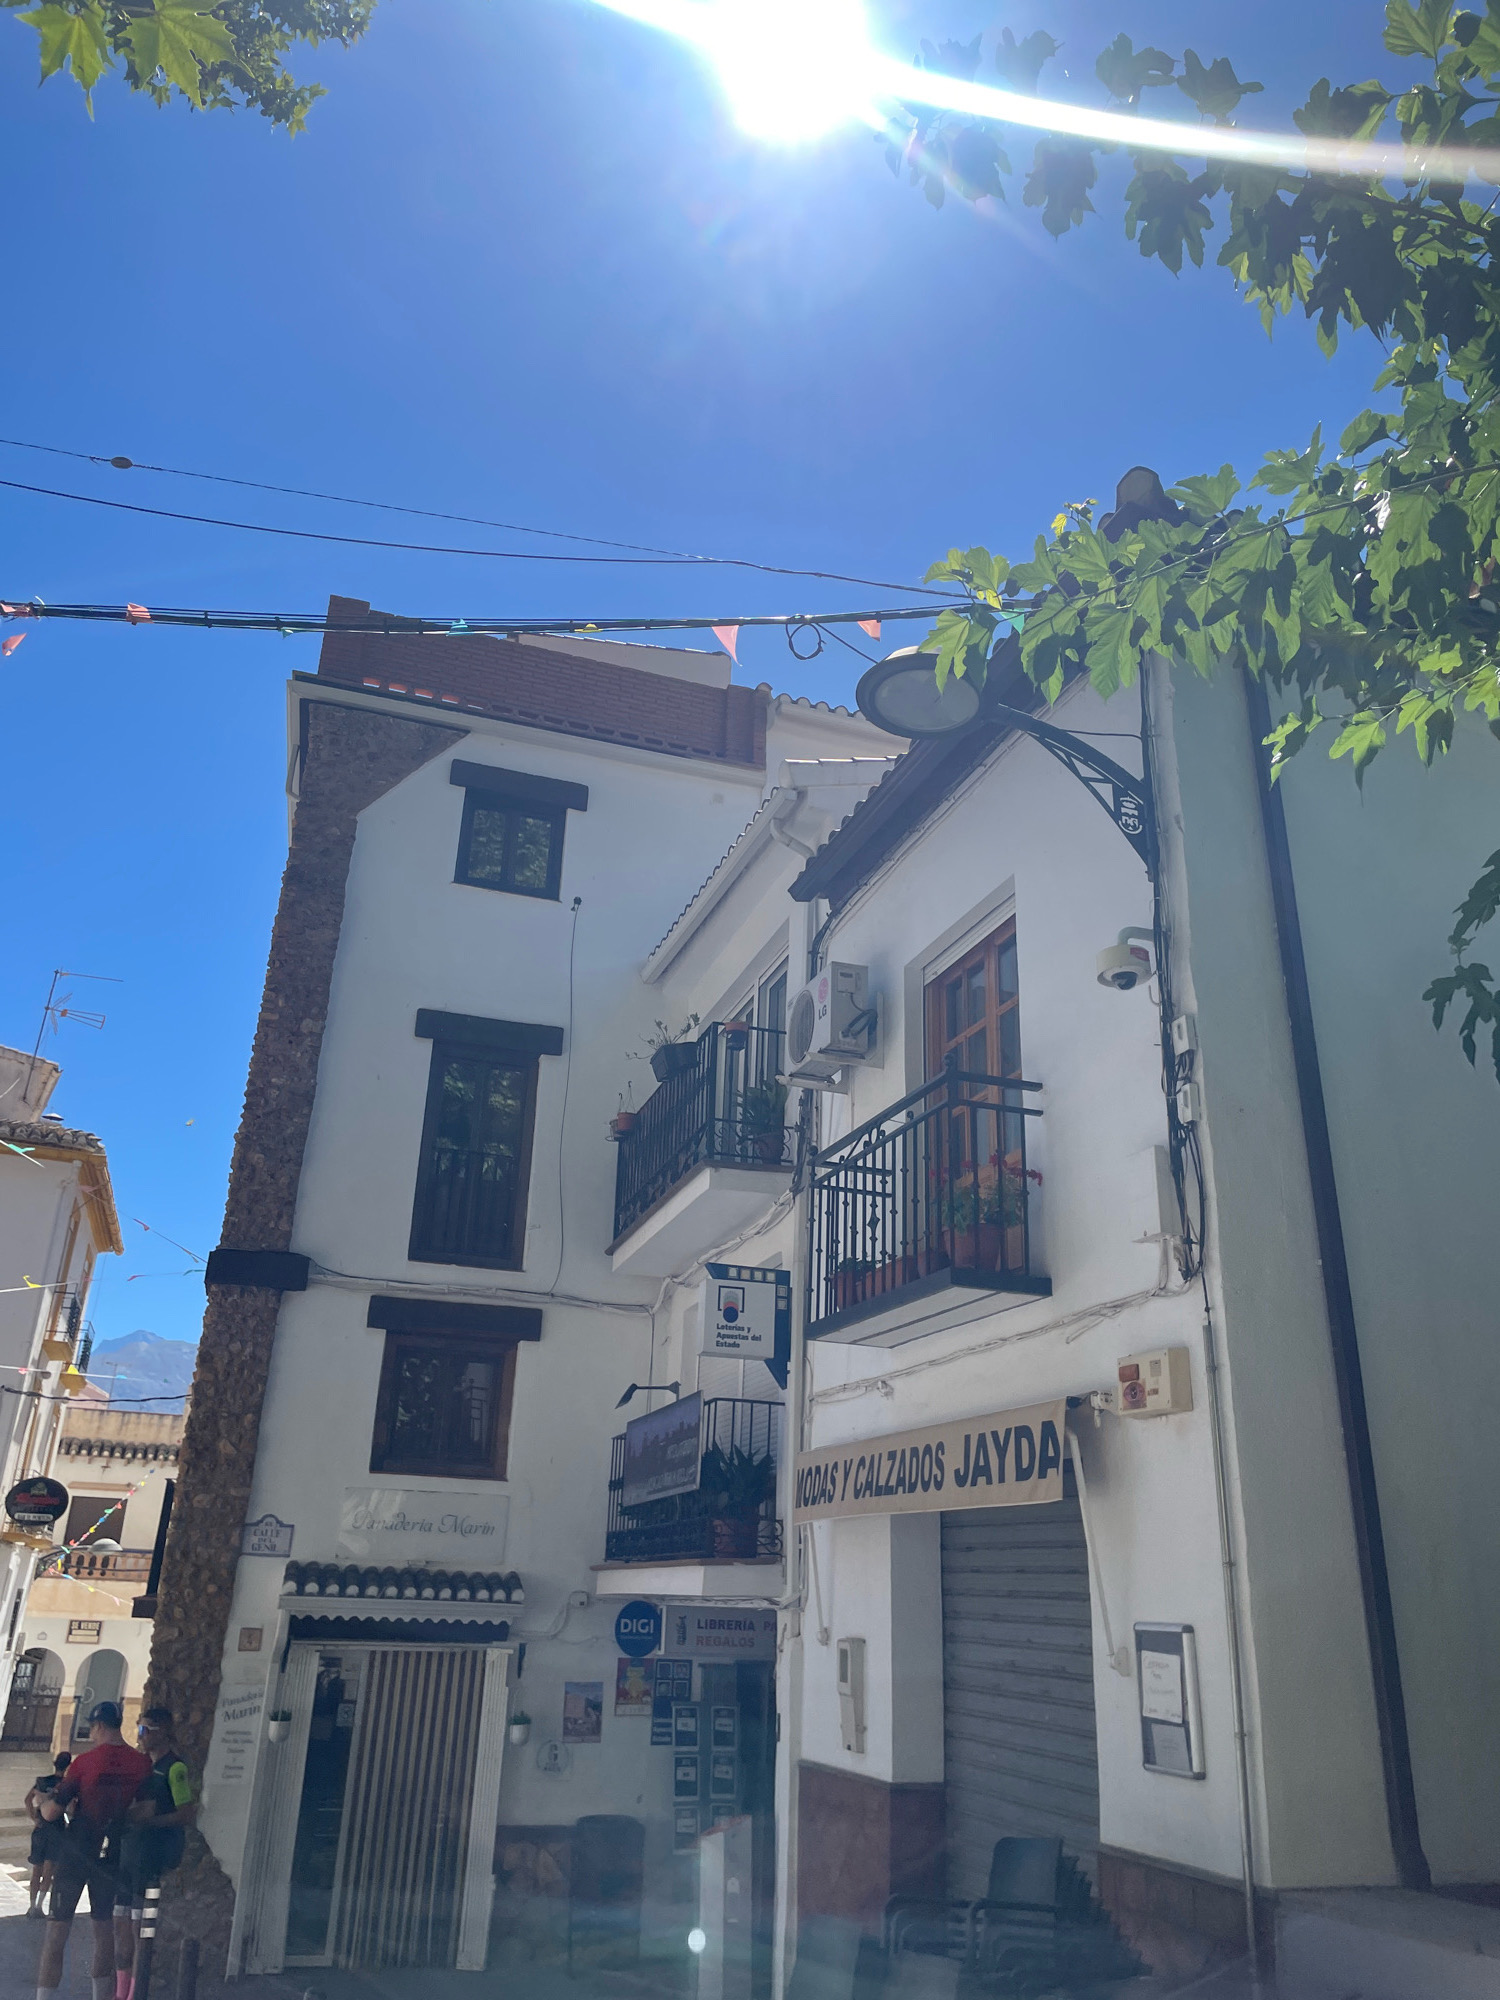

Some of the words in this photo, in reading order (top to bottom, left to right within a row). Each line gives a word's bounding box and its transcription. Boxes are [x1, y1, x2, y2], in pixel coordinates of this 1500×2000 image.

[818, 1005, 827, 1021] LG
[715, 1340, 740, 1348] Estado
[716, 1332, 748, 1341] Apuestas
[840, 1458, 854, 1501] Y
[853, 1440, 946, 1499] CALZADOS
[954, 1419, 1061, 1488] JAYDA
[620, 1618, 654, 1634] DIGI
[696, 1617, 756, 1632] LIBRERÍA
[695, 1636, 755, 1648] REGALOS
